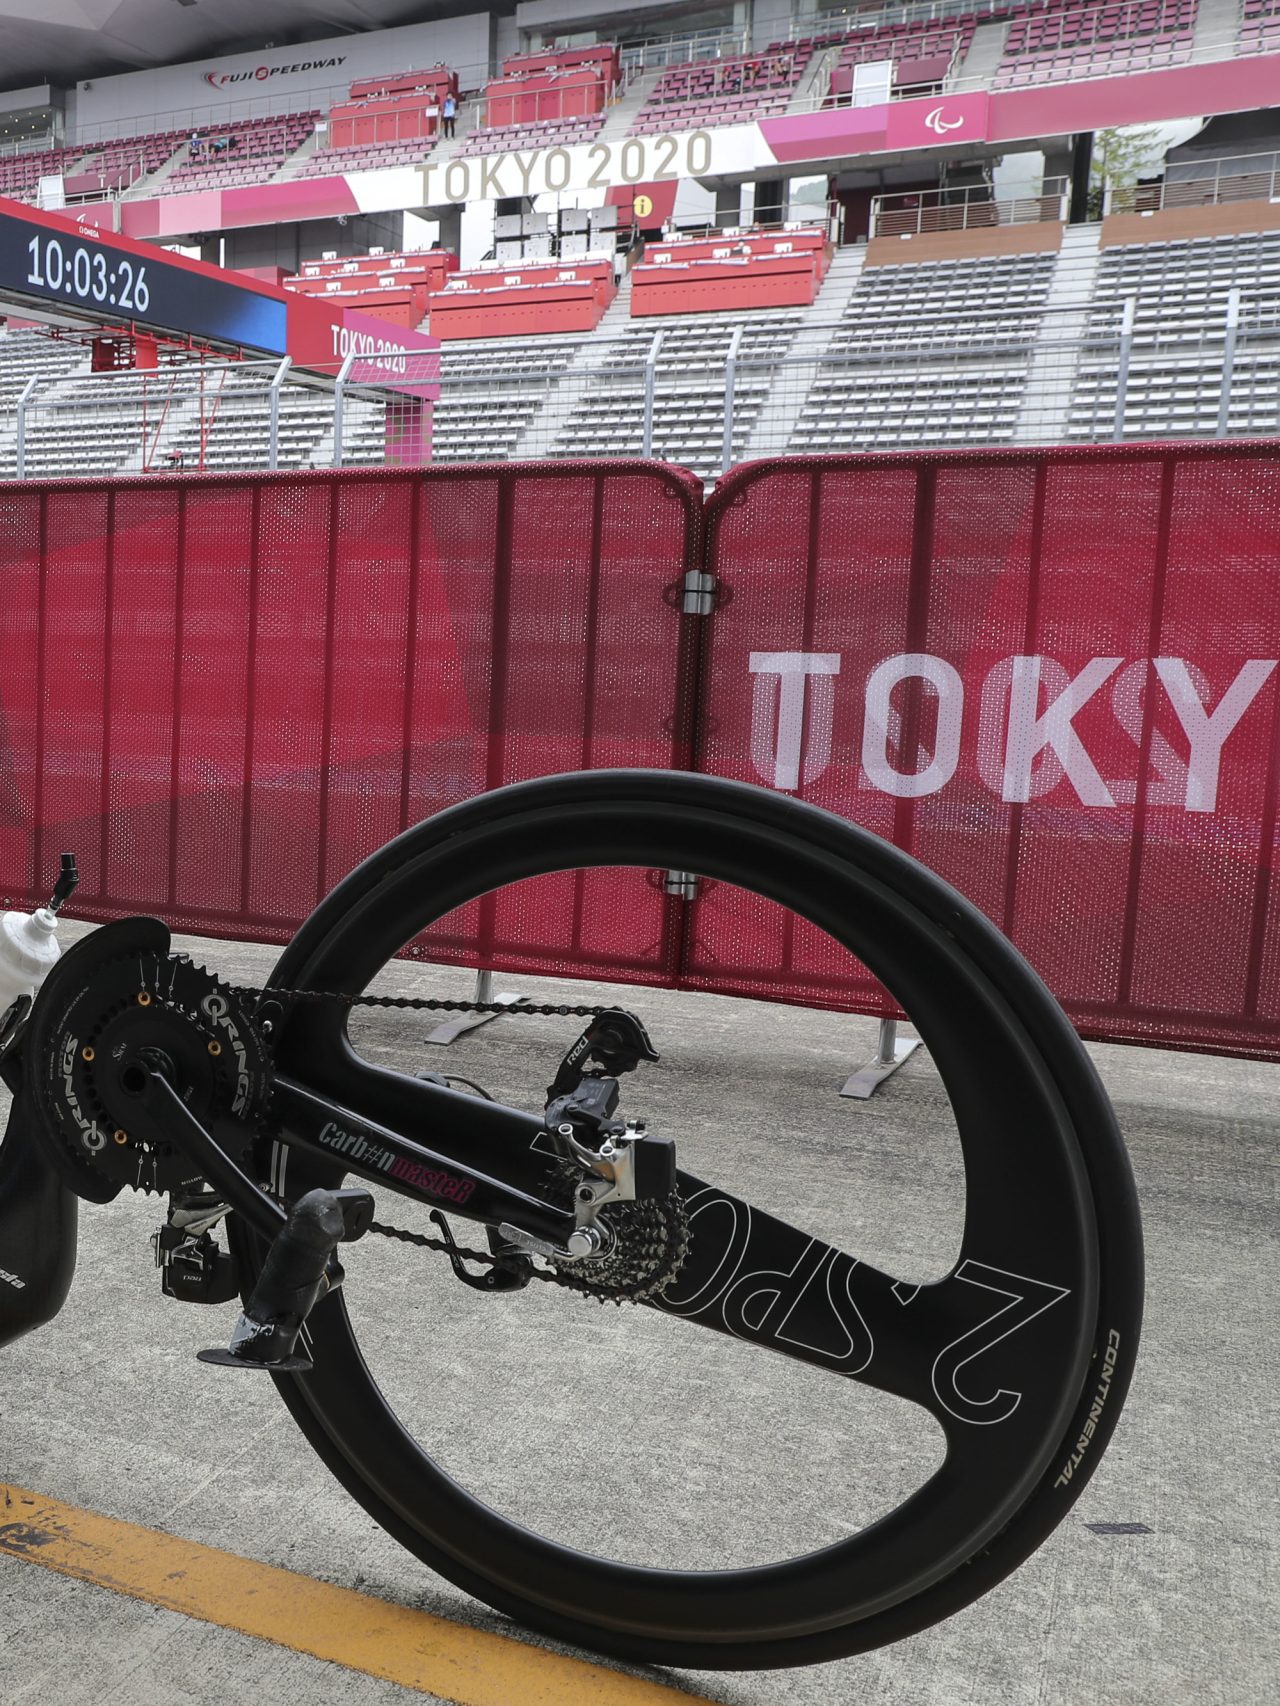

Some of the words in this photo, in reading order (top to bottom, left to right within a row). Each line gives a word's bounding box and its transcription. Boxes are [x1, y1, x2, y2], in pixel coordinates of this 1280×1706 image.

[220, 71, 253, 85] FUJI
[255, 56, 348, 81] SPEEDWAY
[414, 148, 571, 205] TOKYO
[587, 130, 712, 188] 2020
[27, 235, 150, 312] 10:03:26
[330, 323, 375, 366] TOKYO
[376, 338, 406, 374] 2020
[1053, 1328, 1121, 1489] CONTINENTAL
